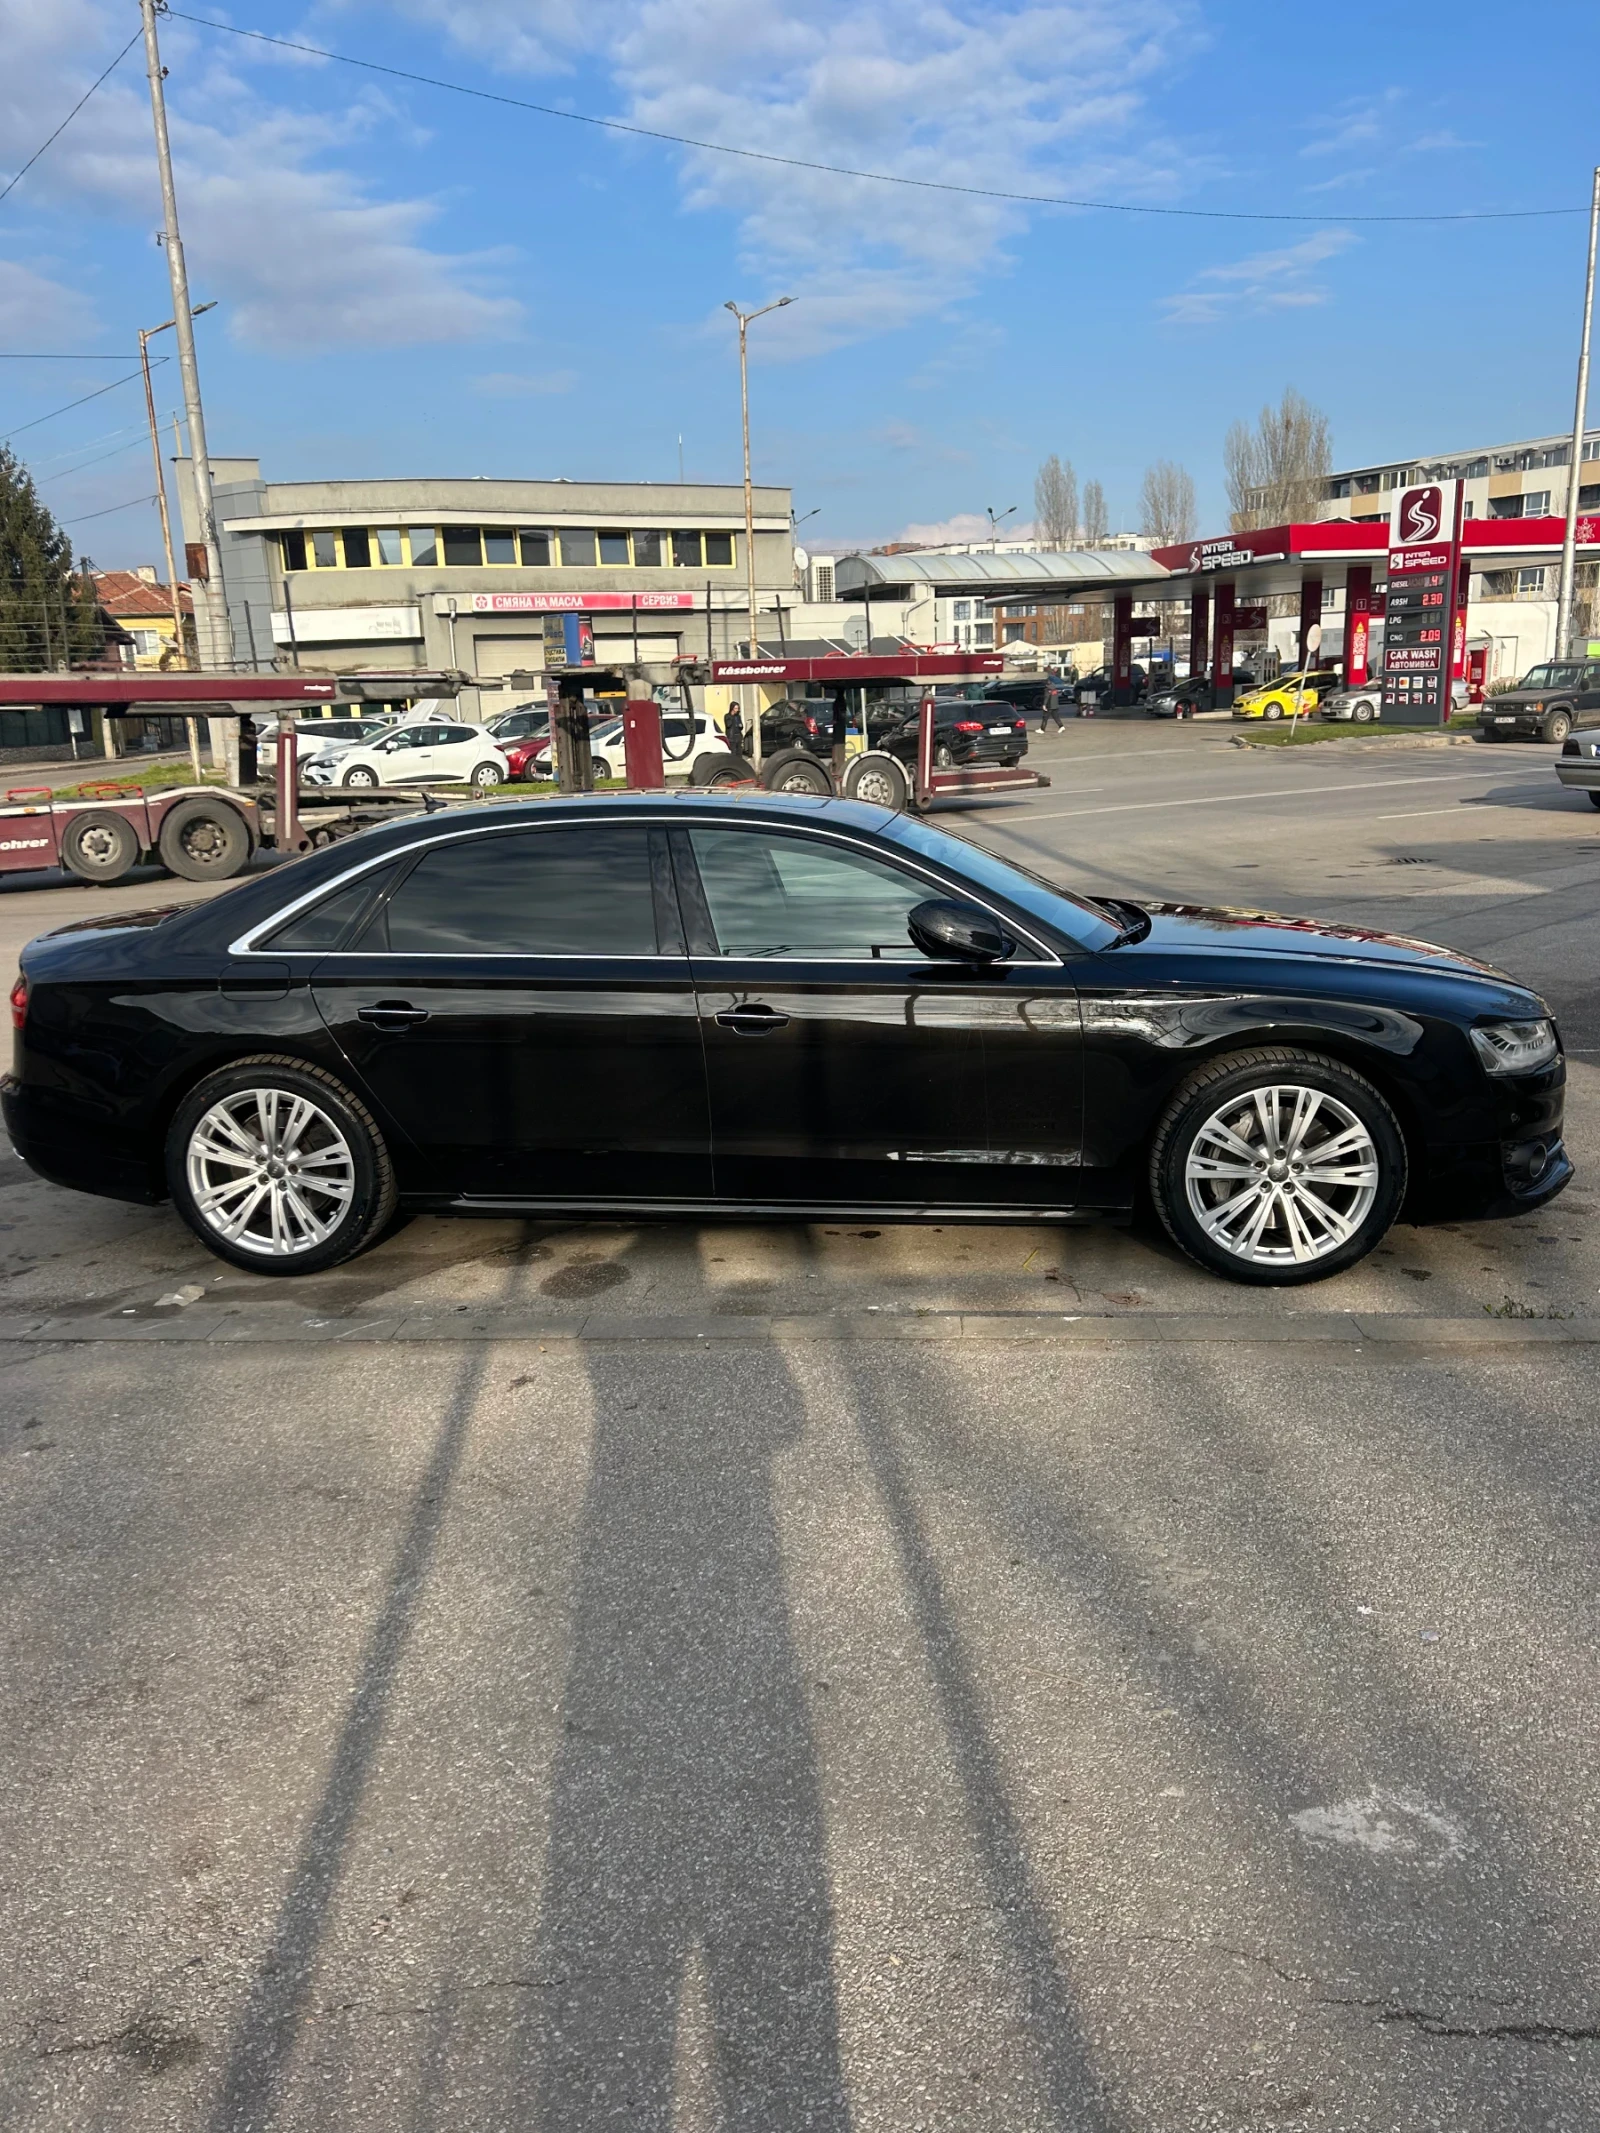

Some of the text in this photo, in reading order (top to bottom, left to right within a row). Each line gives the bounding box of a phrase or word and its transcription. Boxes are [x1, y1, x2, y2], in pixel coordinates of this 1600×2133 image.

[1202, 541, 1234, 554] INTER
[1201, 550, 1253, 570] SPEED
[1405, 551, 1431, 559] INTER
[1404, 556, 1447, 567] SPEED
[495, 595, 584, 608] СМЯНА НА МАСЛА
[641, 594, 679, 606] СЕРВИЗ
[1422, 593, 1443, 606] 2.30
[1389, 616, 1402, 624] LPG
[1389, 629, 1441, 642] CNG 2.09
[1390, 649, 1436, 660] CAR WASH
[1389, 660, 1435, 669] АВТОМИВКА
